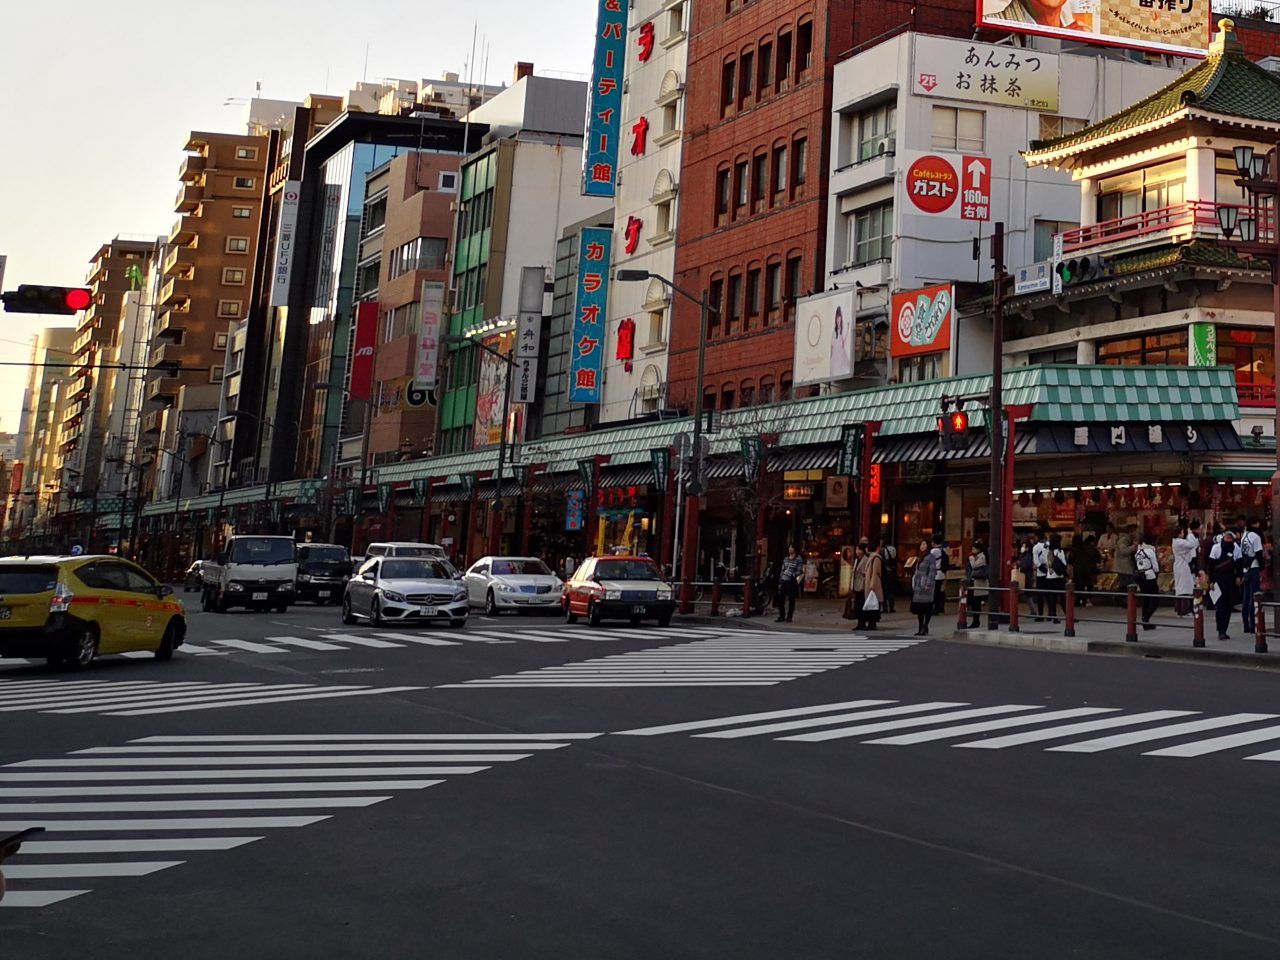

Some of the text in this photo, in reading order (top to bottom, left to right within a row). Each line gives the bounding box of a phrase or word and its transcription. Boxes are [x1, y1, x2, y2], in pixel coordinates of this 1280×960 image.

[964, 46, 1041, 72] あんみつ
[920, 74, 937, 87] 2F
[955, 71, 1022, 98] お抹茶
[913, 179, 954, 198] ガスト
[963, 190, 989, 205] 160m
[963, 205, 989, 219] 右側
[577, 241, 606, 389] カラオケ館
[521, 328, 535, 353] 舟和
[356, 346, 374, 357] JTB
